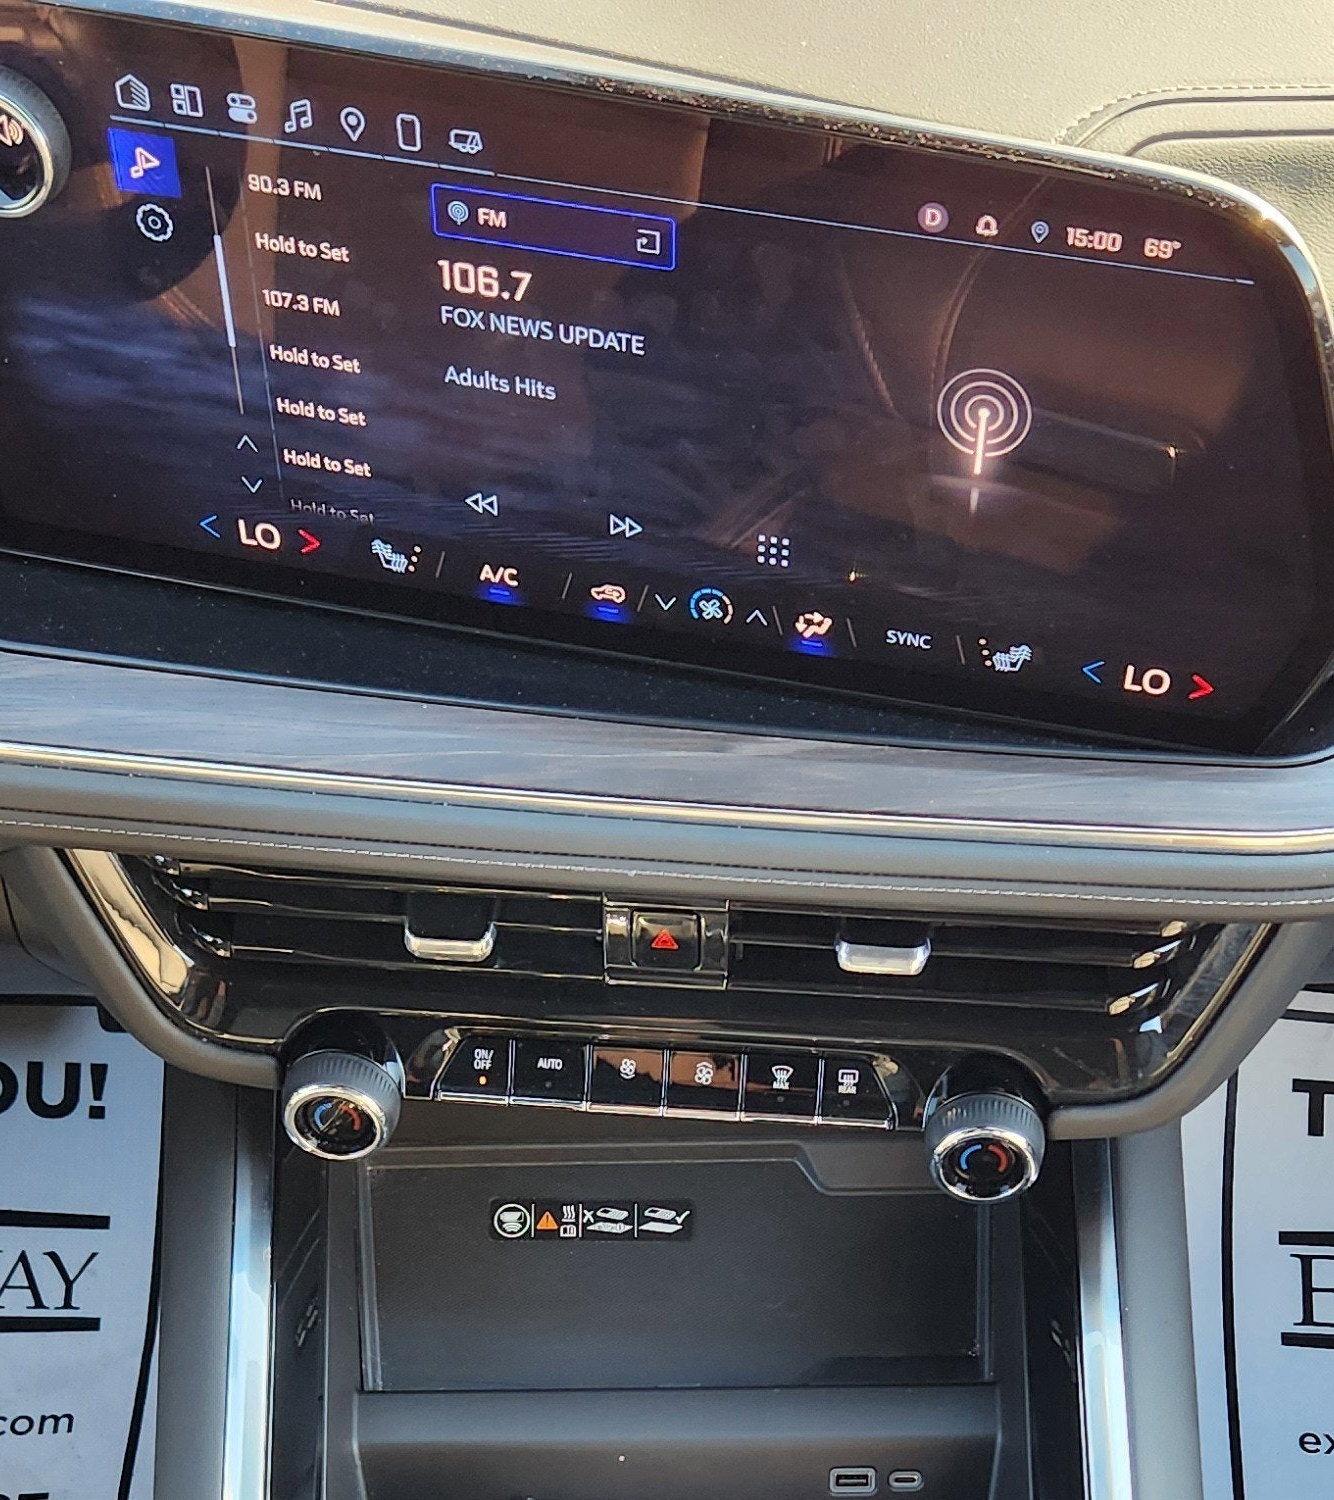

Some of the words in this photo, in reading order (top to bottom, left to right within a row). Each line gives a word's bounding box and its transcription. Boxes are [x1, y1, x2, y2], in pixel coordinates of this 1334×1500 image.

[247, 173, 290, 196] 90.3
[293, 180, 322, 200] FM
[476, 207, 508, 229] FM
[254, 232, 296, 255] Hold
[297, 240, 318, 258] to
[319, 241, 351, 263] Set
[1066, 226, 1123, 252] 15:00
[1143, 237, 1183, 259] 69°
[437, 258, 533, 302] 106.7
[261, 288, 310, 312] 107.3
[312, 297, 342, 317] FM
[440, 305, 486, 331] FOX
[489, 312, 554, 341] NEWS
[558, 323, 646, 356] UPDATE
[269, 344, 309, 367] Hold
[310, 352, 331, 369] to
[332, 354, 361, 374] Set
[444, 365, 510, 394] Adults
[514, 376, 557, 400] Hits
[276, 397, 315, 418] Hold
[316, 404, 337, 422] to
[337, 407, 368, 427] Set
[283, 448, 322, 470] Hold
[323, 455, 343, 473] to
[343, 458, 373, 478] Set
[237, 518, 281, 550] LO
[479, 564, 519, 587] A/C
[885, 629, 933, 650] SYNC
[1122, 664, 1171, 695] LO
[473, 1060, 493, 1070] OFF
[536, 1058, 564, 1071] AUTO
